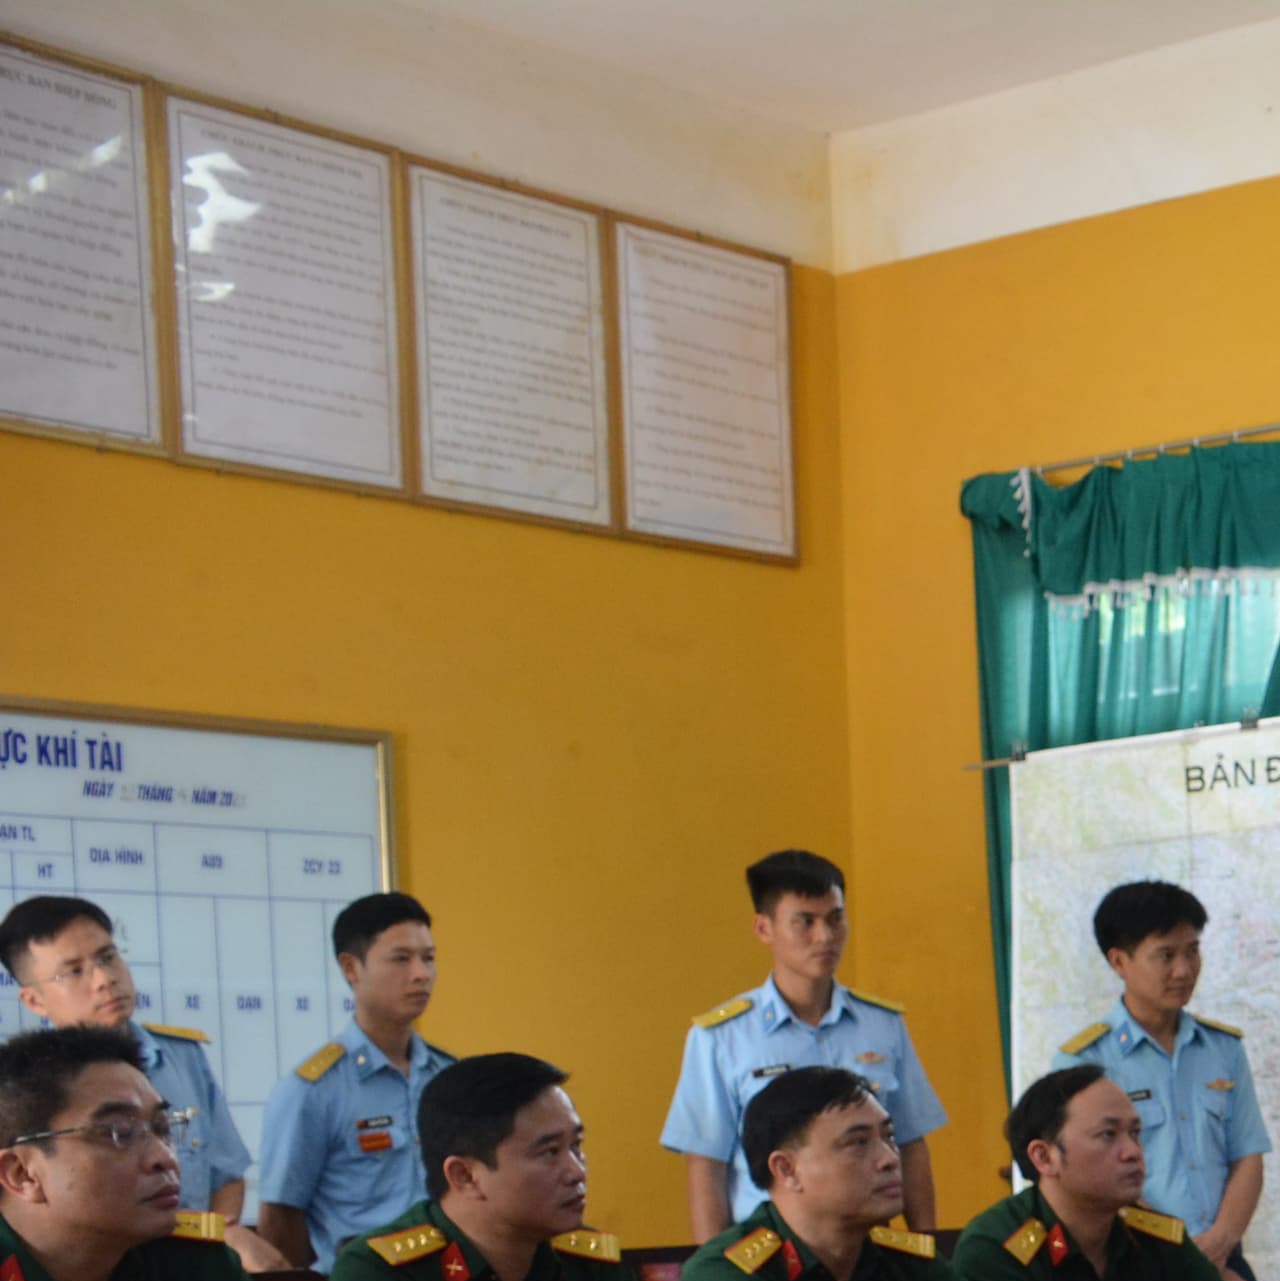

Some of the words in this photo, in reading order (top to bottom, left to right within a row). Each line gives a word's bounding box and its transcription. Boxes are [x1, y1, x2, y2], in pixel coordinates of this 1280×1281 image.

[36, 730, 77, 769] KHÍ
[85, 732, 123, 772] TÀI
[1185, 752, 1256, 793] BẢN
[38, 862, 53, 879] HT
